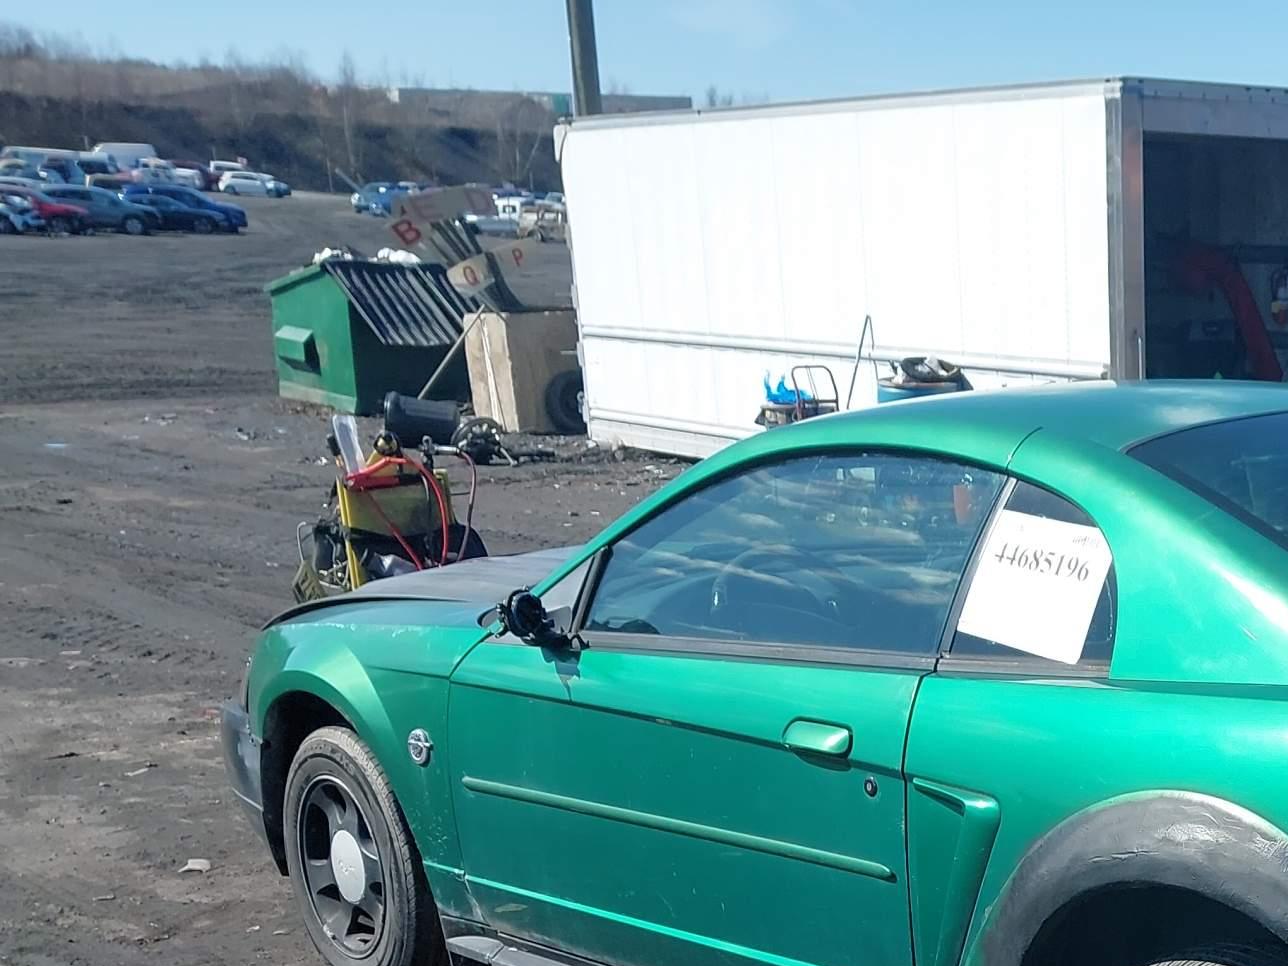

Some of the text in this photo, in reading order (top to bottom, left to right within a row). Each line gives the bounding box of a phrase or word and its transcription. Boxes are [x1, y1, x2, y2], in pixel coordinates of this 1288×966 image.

[391, 218, 422, 245] B
[511, 248, 524, 267] P
[994, 542, 1089, 582] 44685196
